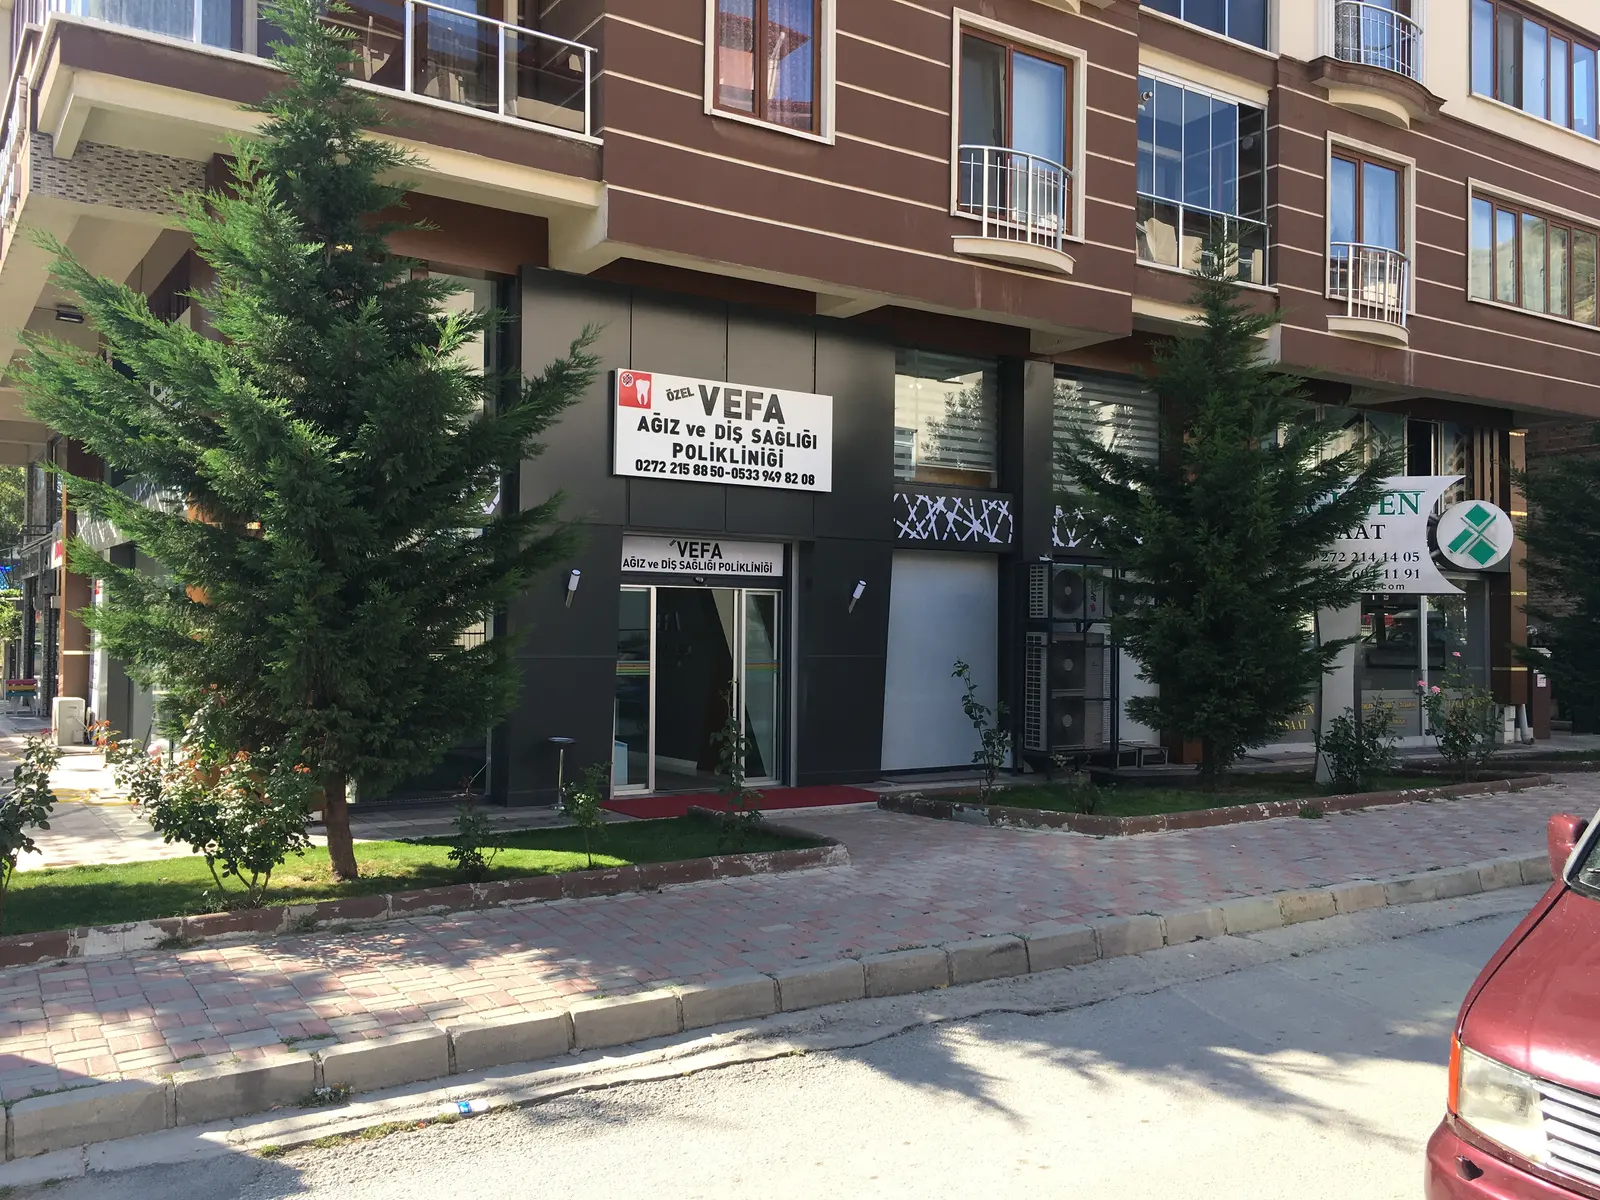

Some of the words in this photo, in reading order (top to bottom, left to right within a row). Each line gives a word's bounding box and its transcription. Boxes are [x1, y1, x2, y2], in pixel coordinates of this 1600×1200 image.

[666, 387, 695, 402] ÖZEL
[698, 384, 786, 425] VEFA
[637, 412, 680, 435] AĞIZ
[686, 424, 706, 438] ve
[714, 420, 743, 444] DİŞ
[751, 426, 817, 450] SAĞLIĞI
[672, 441, 784, 469] POLİKLİNİĞİ
[635, 459, 667, 474] 0272
[670, 462, 690, 476] 215
[693, 464, 708, 477] 88
[762, 470, 782, 483] 949
[784, 472, 799, 485] 82
[801, 473, 815, 486] 08
[677, 541, 723, 560] VEFA
[1321, 552, 1346, 562] 272
[1351, 551, 1376, 562] 214
[1382, 551, 1398, 562] 14
[1403, 551, 1420, 562] 05
[622, 556, 646, 569] AĞIZ
[648, 561, 659, 569] ve
[661, 557, 677, 571] DİŞ
[679, 558, 716, 572] SAĞLIĞI
[718, 560, 773, 574] POLİKLİNİĞİ
[1384, 568, 1398, 579] 11
[1404, 568, 1420, 579] 91
